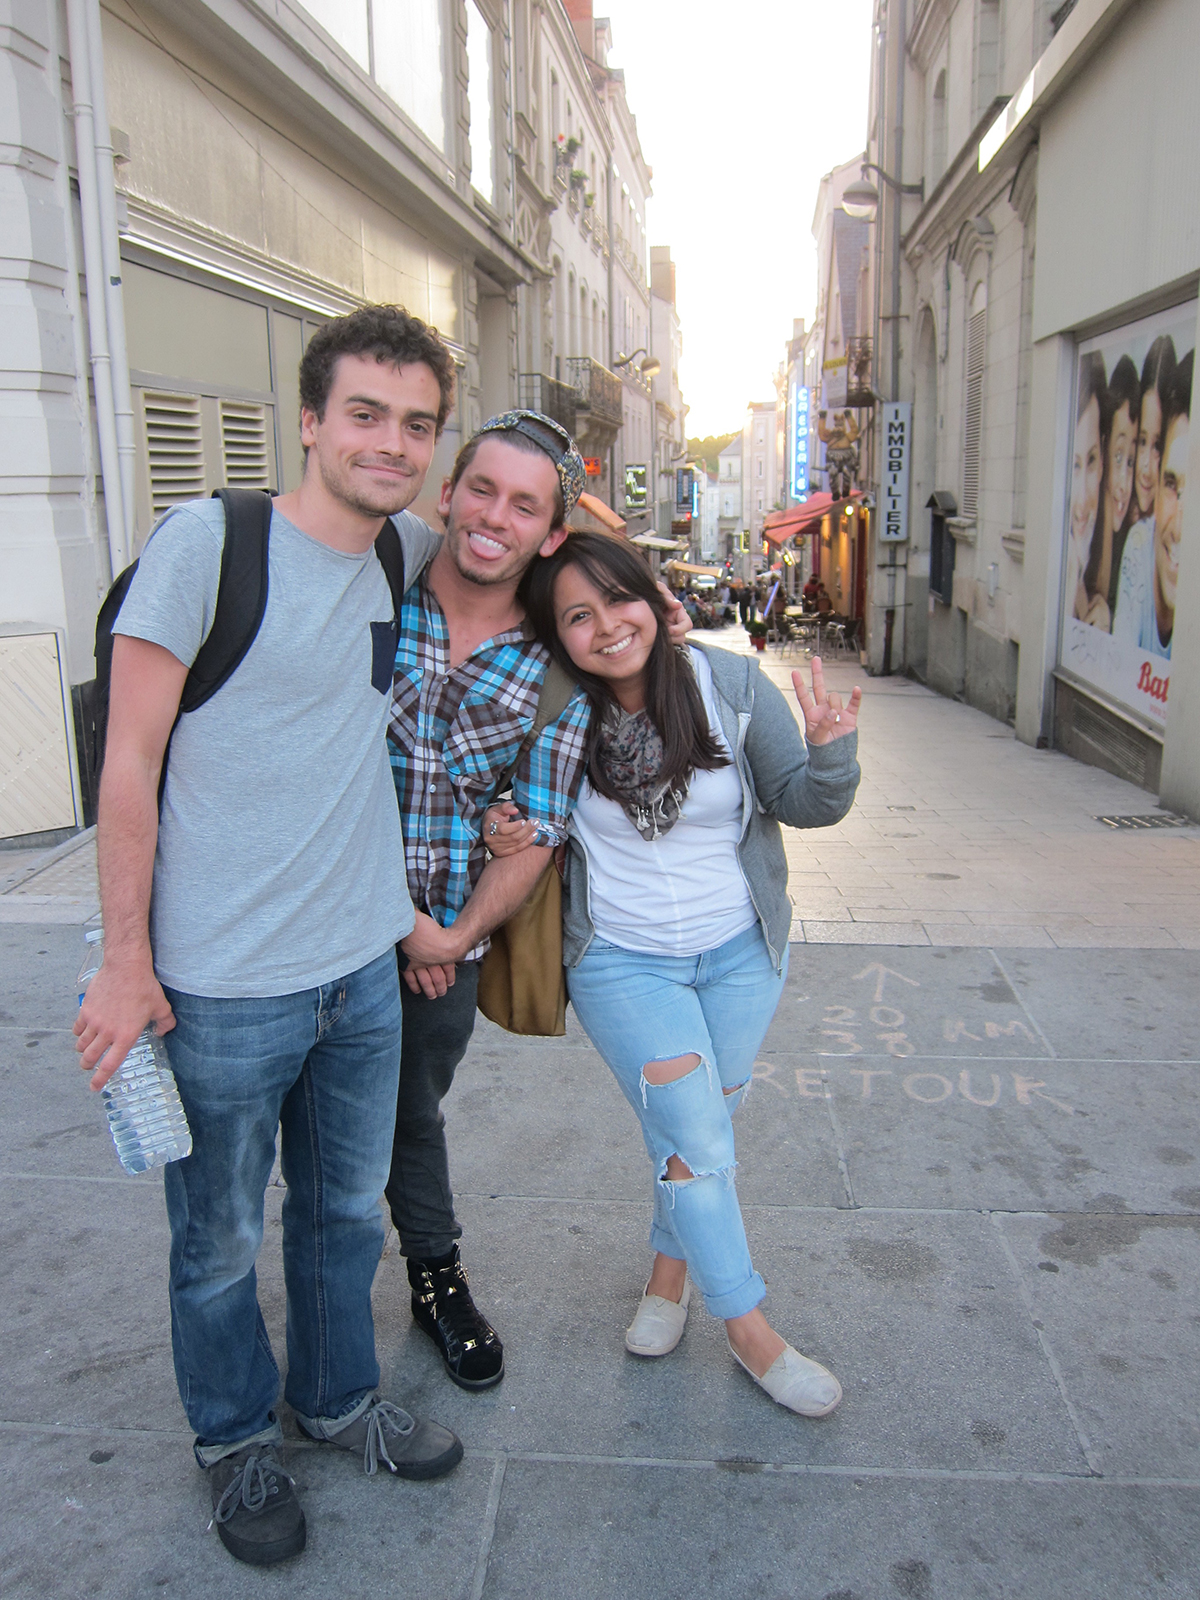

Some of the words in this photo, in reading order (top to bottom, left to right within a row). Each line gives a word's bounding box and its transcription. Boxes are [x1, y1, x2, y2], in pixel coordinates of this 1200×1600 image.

[886, 408, 905, 535] IMMOBILIER
[821, 1005, 906, 1027] 20
[751, 1060, 1075, 1116] RETOUR
